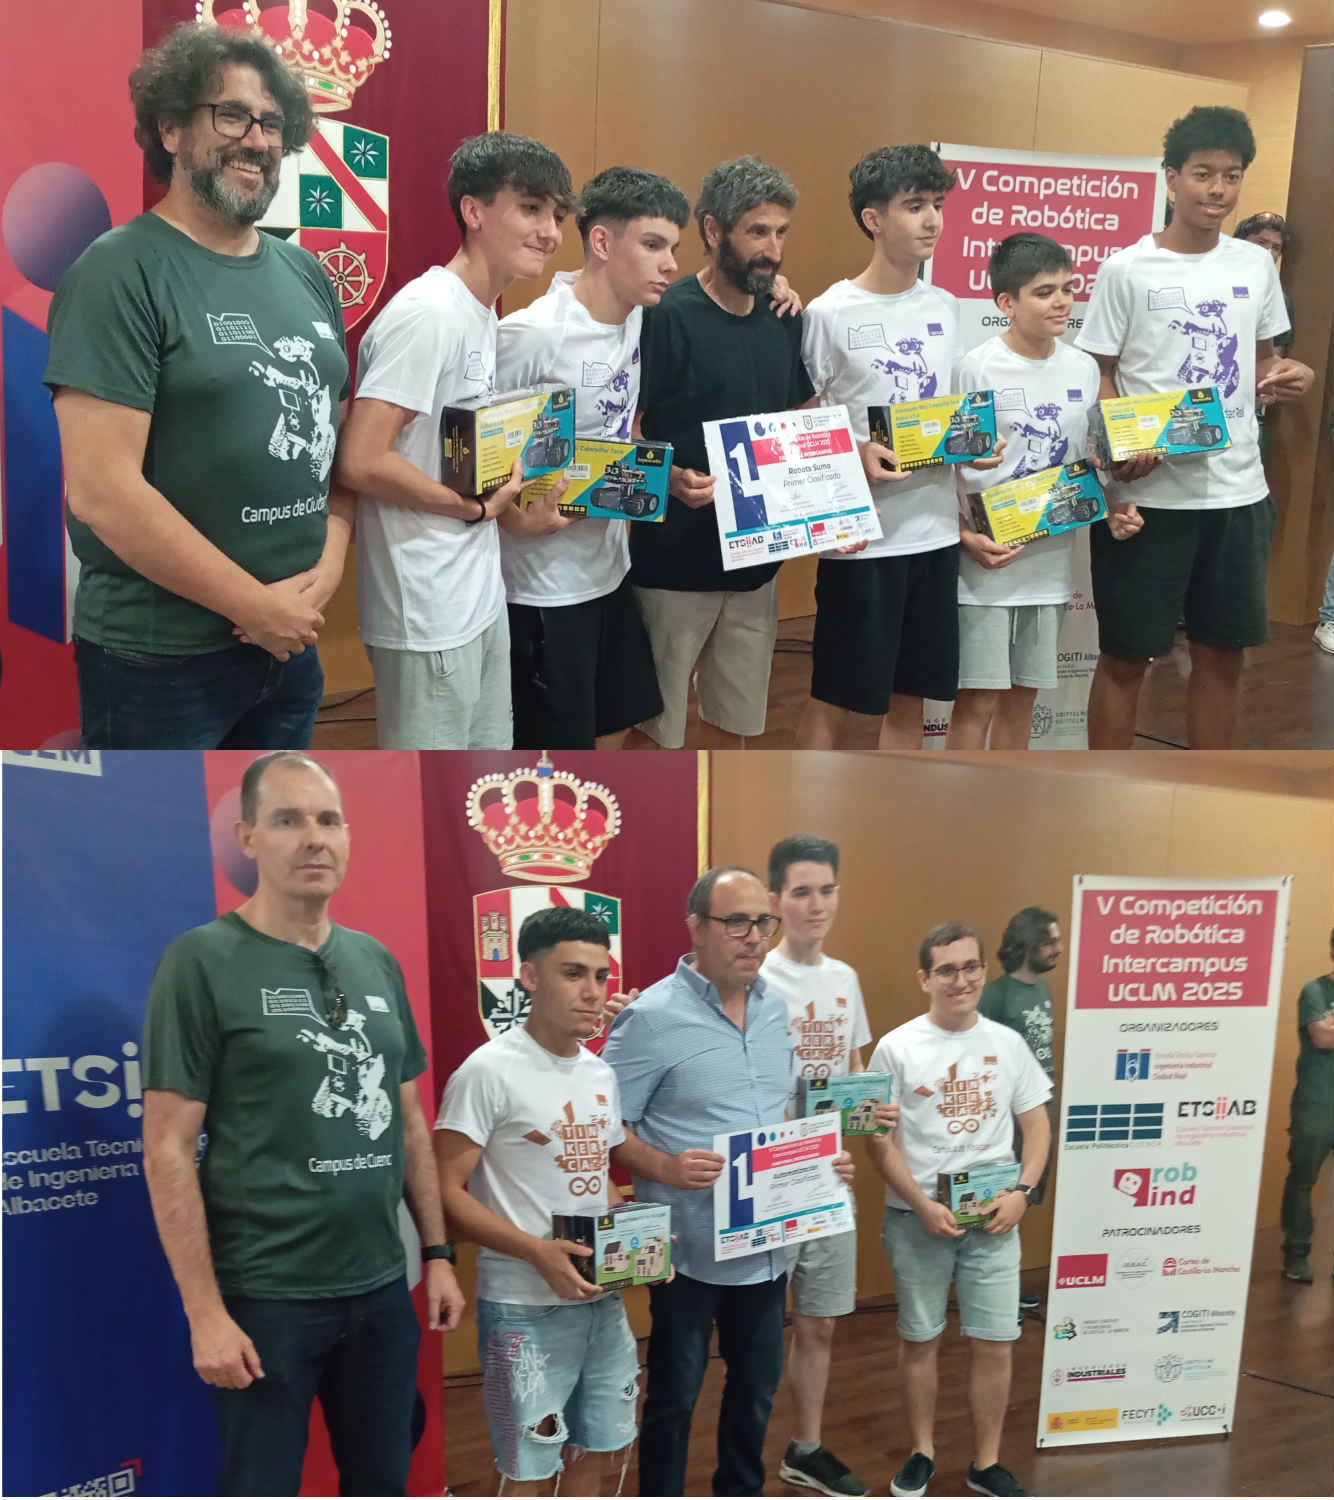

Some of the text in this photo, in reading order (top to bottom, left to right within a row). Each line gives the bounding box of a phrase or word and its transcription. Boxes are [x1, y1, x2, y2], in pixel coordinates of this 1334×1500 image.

[957, 168, 1138, 200] V Competición
[971, 202, 1119, 230] de Robótica
[580, 446, 610, 454] Caterpillar
[788, 466, 812, 475] Robots
[783, 478, 806, 488] Primer
[241, 505, 291, 526] Campus
[292, 499, 305, 516] de
[1073, 590, 1082, 599] de
[1058, 652, 1082, 662] OGITI
[1097, 894, 1264, 920] V Competición
[1110, 923, 1245, 944] de Robótica
[1102, 954, 1248, 978] Intercampus
[1108, 982, 1243, 1002] UCLM 2025
[1120, 1021, 1220, 1032] ORGANIZADORES
[2, 1138, 144, 1166] scuela Técni
[308, 1153, 392, 1176] Campus de Cuenc
[1152, 1162, 1198, 1183] rob
[28, 1161, 139, 1190] Ingeniería
[1150, 1185, 1197, 1207] ind
[1102, 1224, 1202, 1238] PATROCINADORES
[1066, 1275, 1105, 1286] UCLM
[1181, 1310, 1210, 1319] COGITI
[1066, 1368, 1126, 1378] INDUSTRIALES
[1122, 1408, 1156, 1419] FECYT
